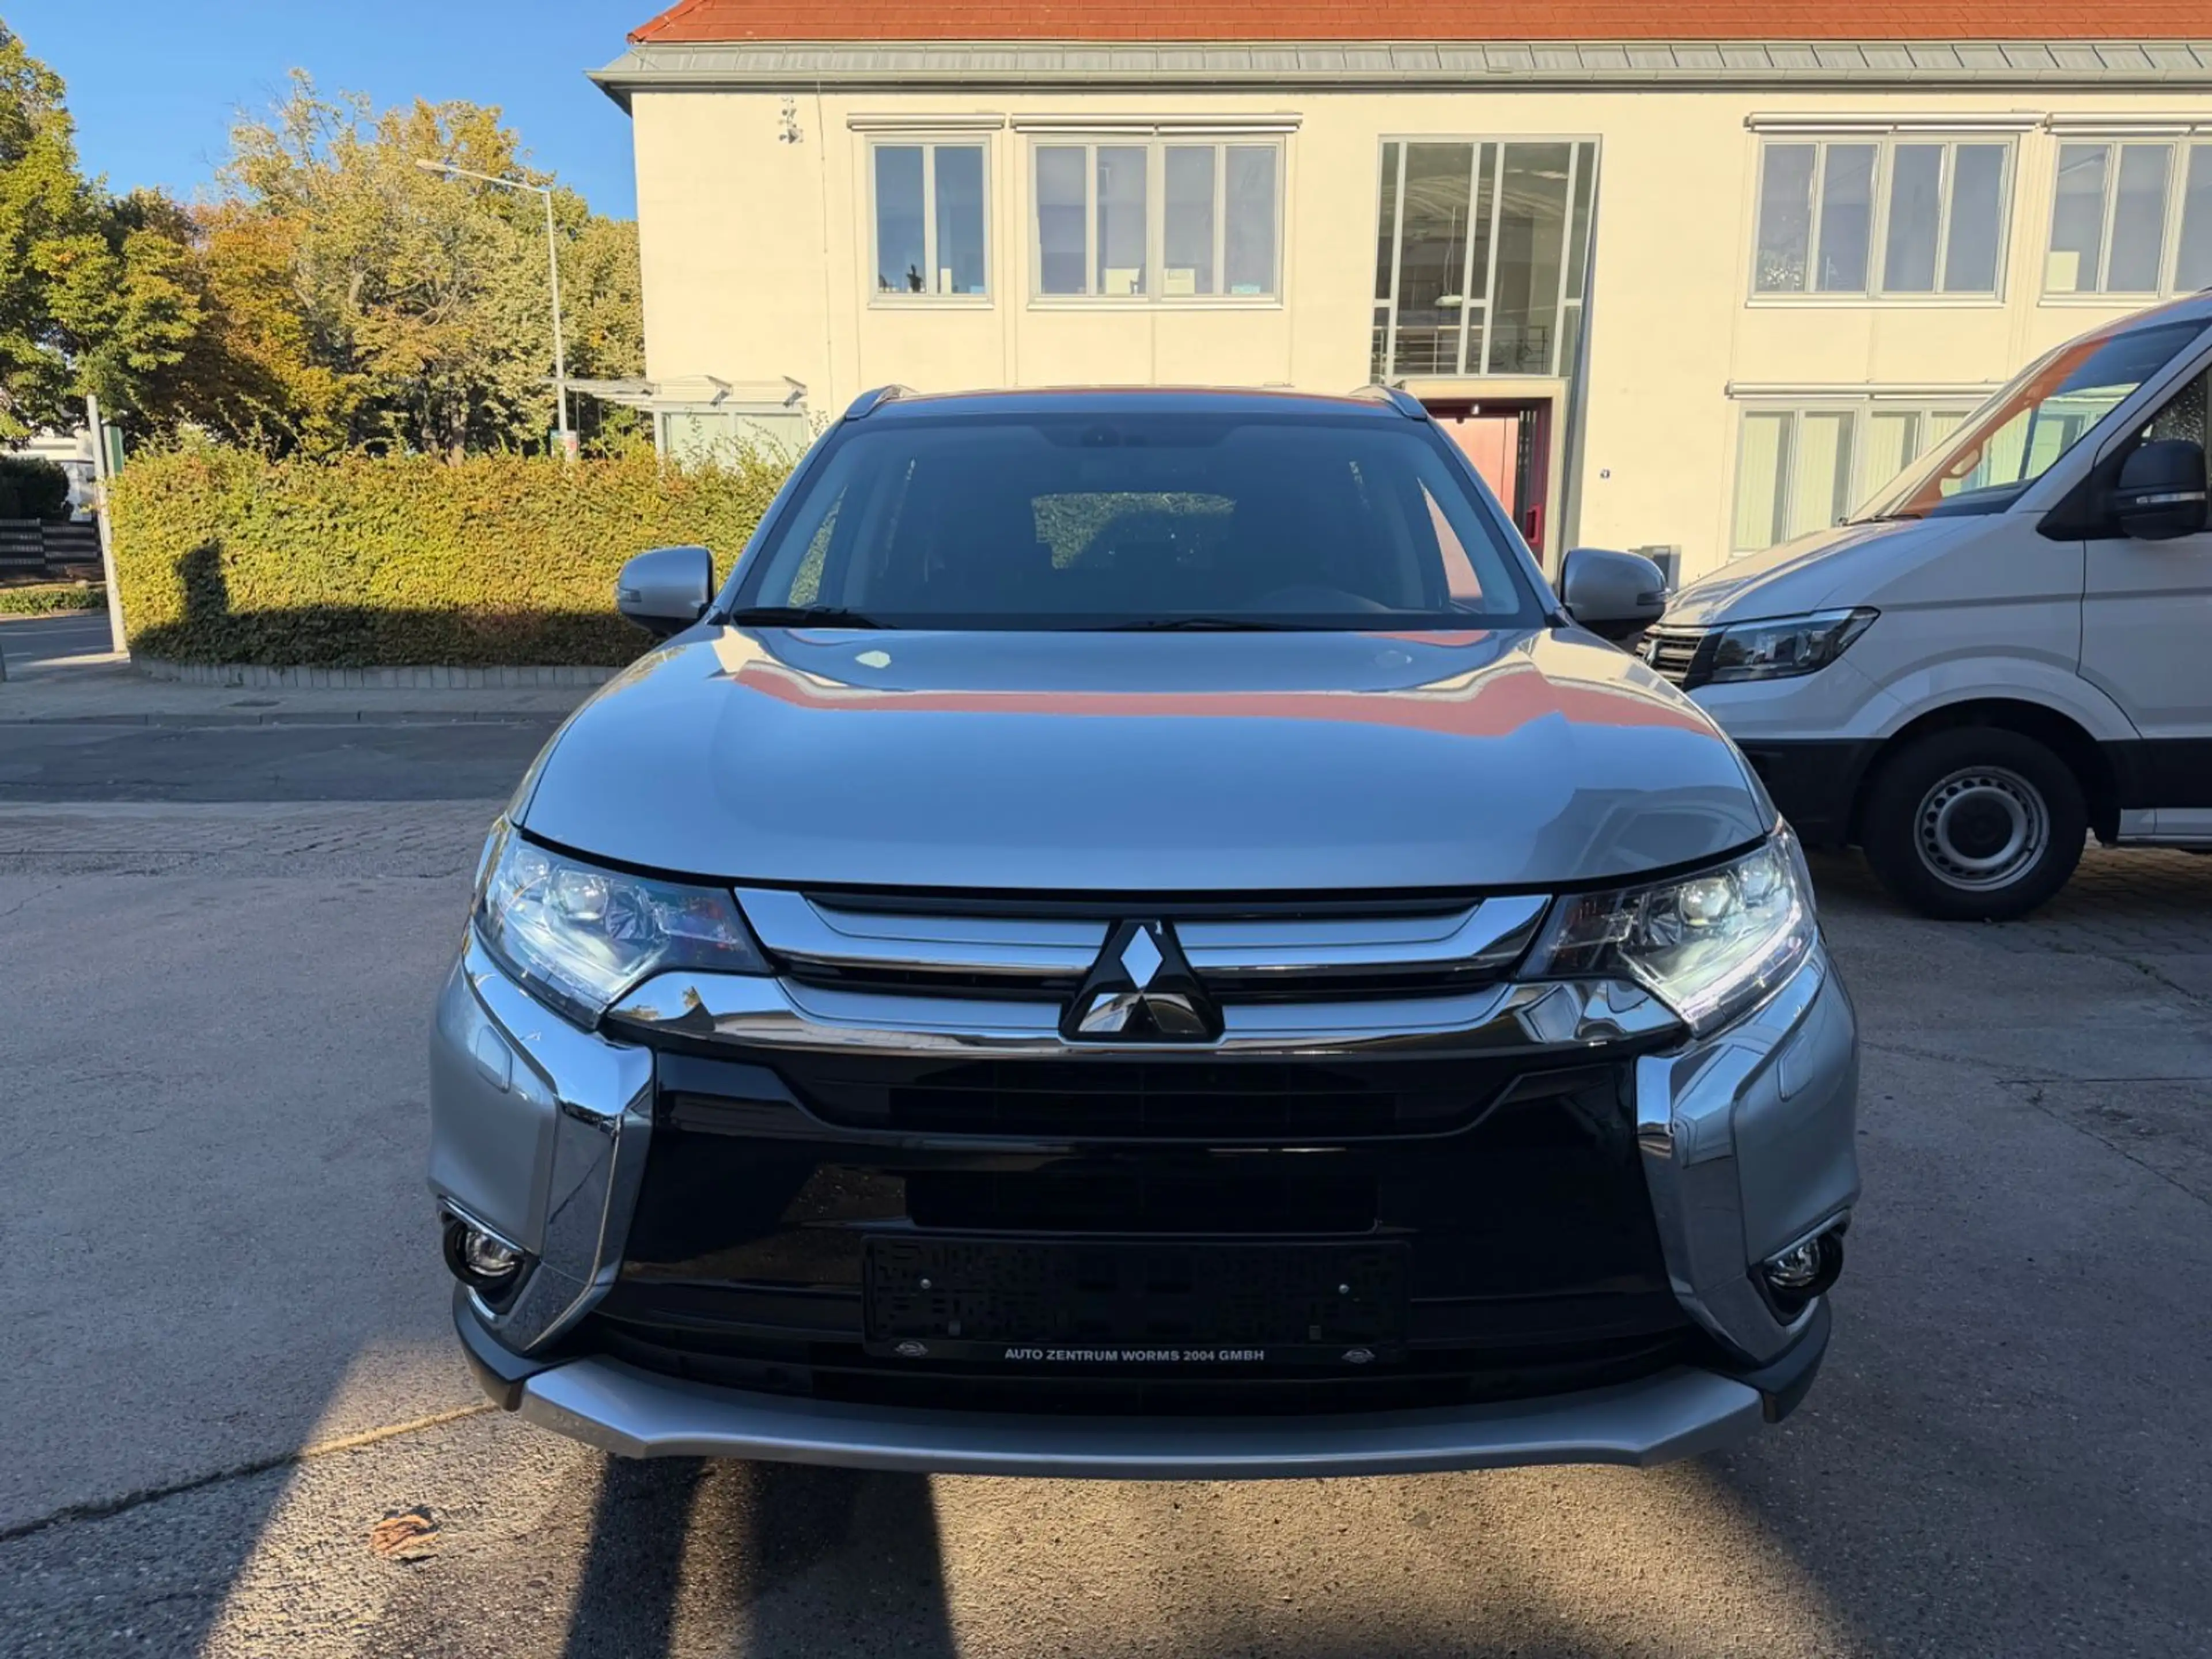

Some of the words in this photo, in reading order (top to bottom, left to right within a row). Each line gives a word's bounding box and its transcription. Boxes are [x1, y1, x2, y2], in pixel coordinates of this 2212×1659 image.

[1005, 1349, 1044, 1359] AUTO
[1046, 1350, 1118, 1361] ZENTRUM
[1120, 1350, 1180, 1361] WORMS
[1183, 1351, 1215, 1361] 2004
[1218, 1350, 1264, 1361] GMBH
